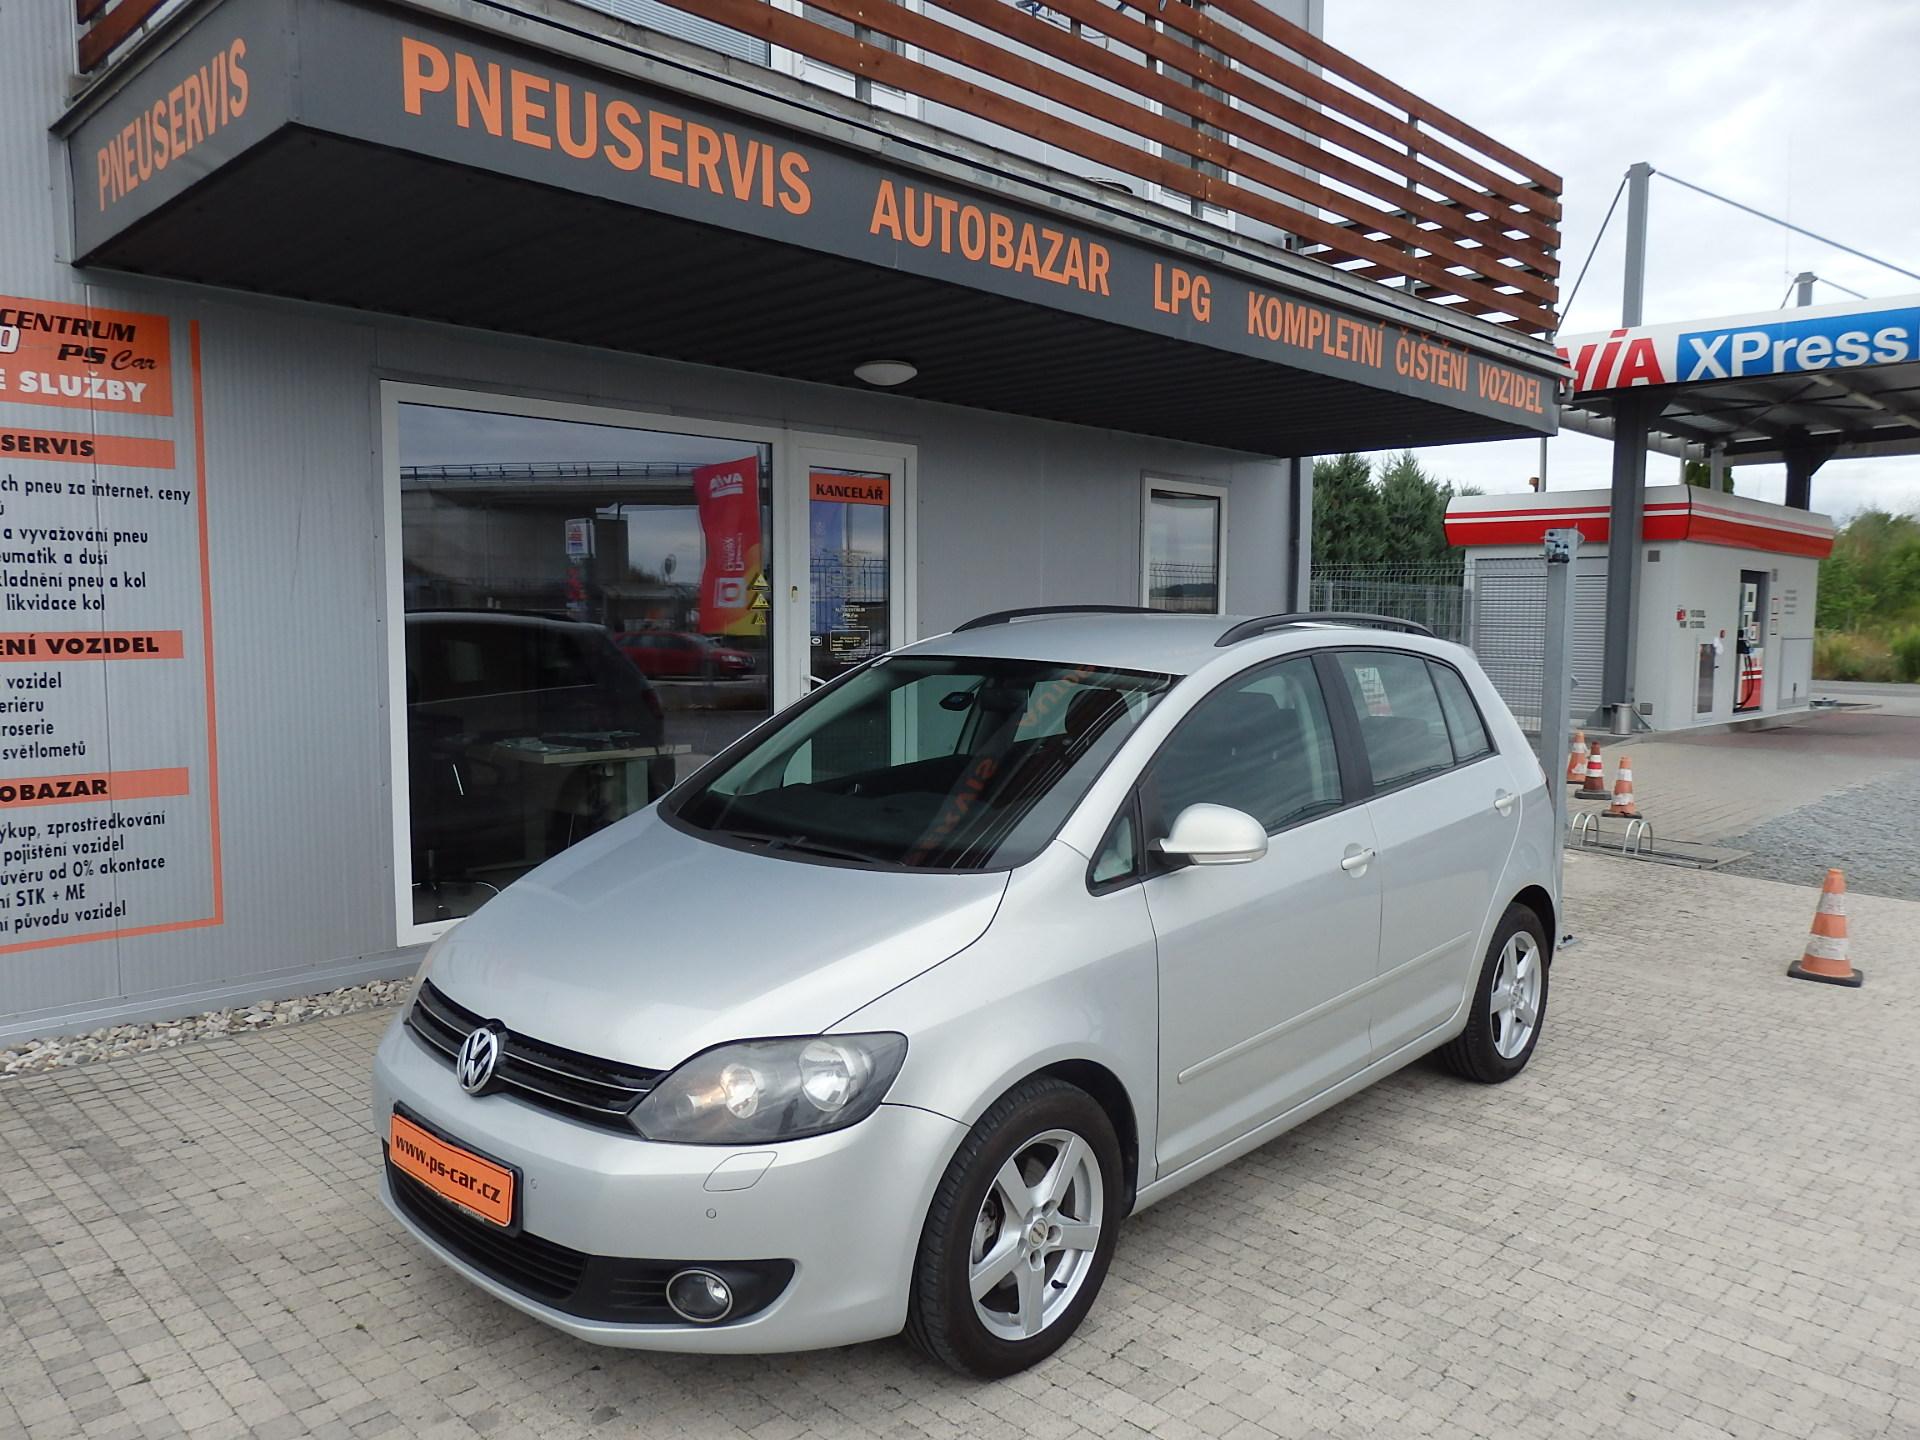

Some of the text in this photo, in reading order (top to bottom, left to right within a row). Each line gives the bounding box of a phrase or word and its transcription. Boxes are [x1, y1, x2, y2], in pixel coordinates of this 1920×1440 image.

[97, 37, 249, 211] PNEUSERVIS
[402, 36, 1544, 414] PNEUSERVIS AUTOBAZAR LPG KOMPLETNÍ ČIŠTĚNÍ VOZIDEL
[0, 308, 136, 342] CENTRUM
[57, 343, 157, 371] PS Car
[1686, 325, 1910, 382] XPress
[19, 370, 148, 403] SLUŽBY
[1, 434, 95, 457] SERVIS
[25, 480, 62, 497] pneu
[68, 483, 86, 496] za
[92, 479, 154, 500] internet.
[158, 487, 191, 505] ceny
[815, 482, 884, 501] KANCELÁŘ
[3, 528, 13, 540] a
[114, 530, 149, 547] pneu
[0, 547, 57, 565] umatik
[64, 553, 73, 564] a
[0, 569, 147, 592] ladnění pneu a kol
[6, 592, 105, 611] likvidace kol
[46, 636, 159, 655] VOZIDEL
[7, 671, 62, 689] vozidel
[2, 718, 55, 737] roserie
[2, 740, 87, 760] světlometů
[0, 778, 109, 803] OBAZAR
[47, 810, 166, 836] zprostředkování
[4, 833, 125, 867] pojištění vozidel
[1, 867, 44, 887] úvěru
[49, 863, 67, 880] od
[99, 856, 166, 875] akontace
[16, 887, 46, 908] STK
[65, 882, 86, 901] ME
[15, 906, 69, 935] původu
[74, 899, 127, 921] vozidel
[395, 1134, 501, 1204] www.ps-car.cz
